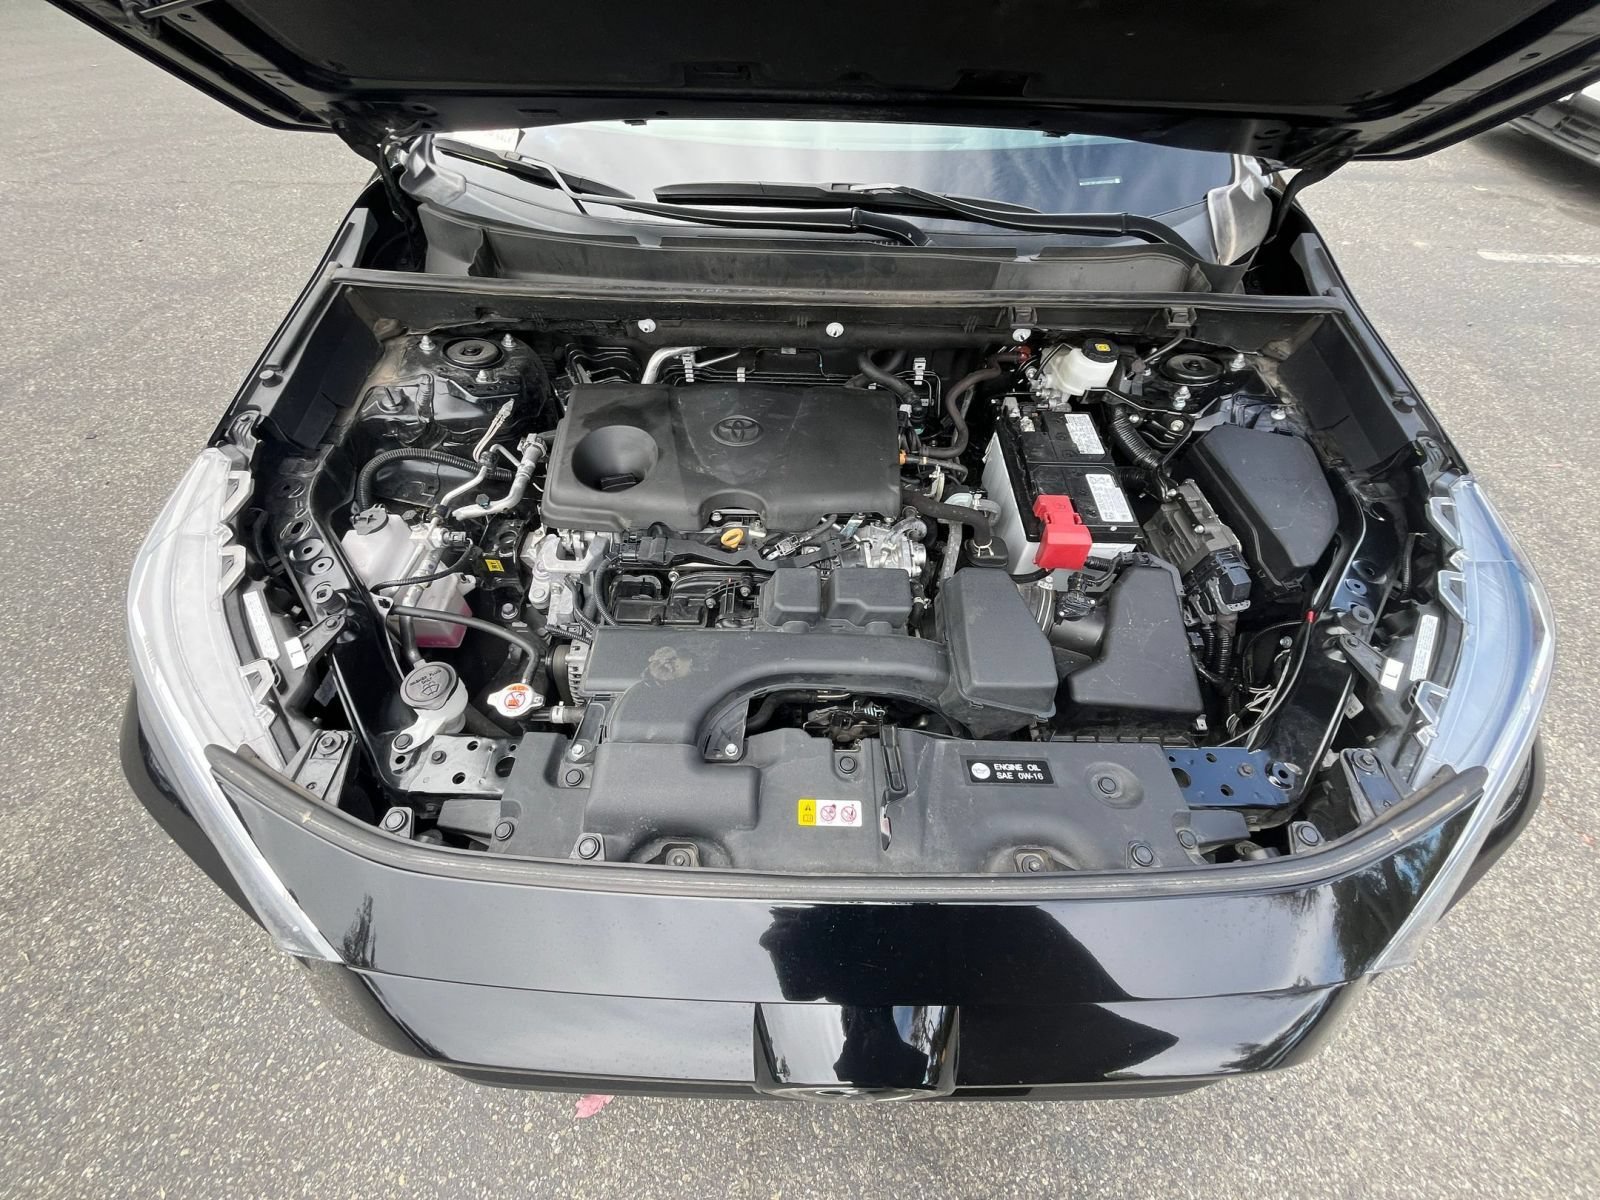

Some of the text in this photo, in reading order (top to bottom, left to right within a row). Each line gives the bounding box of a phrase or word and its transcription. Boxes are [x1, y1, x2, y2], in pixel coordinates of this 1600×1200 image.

[993, 763, 1041, 772] ENGINE OIL
[996, 771, 1044, 781] SAE 0W-16
